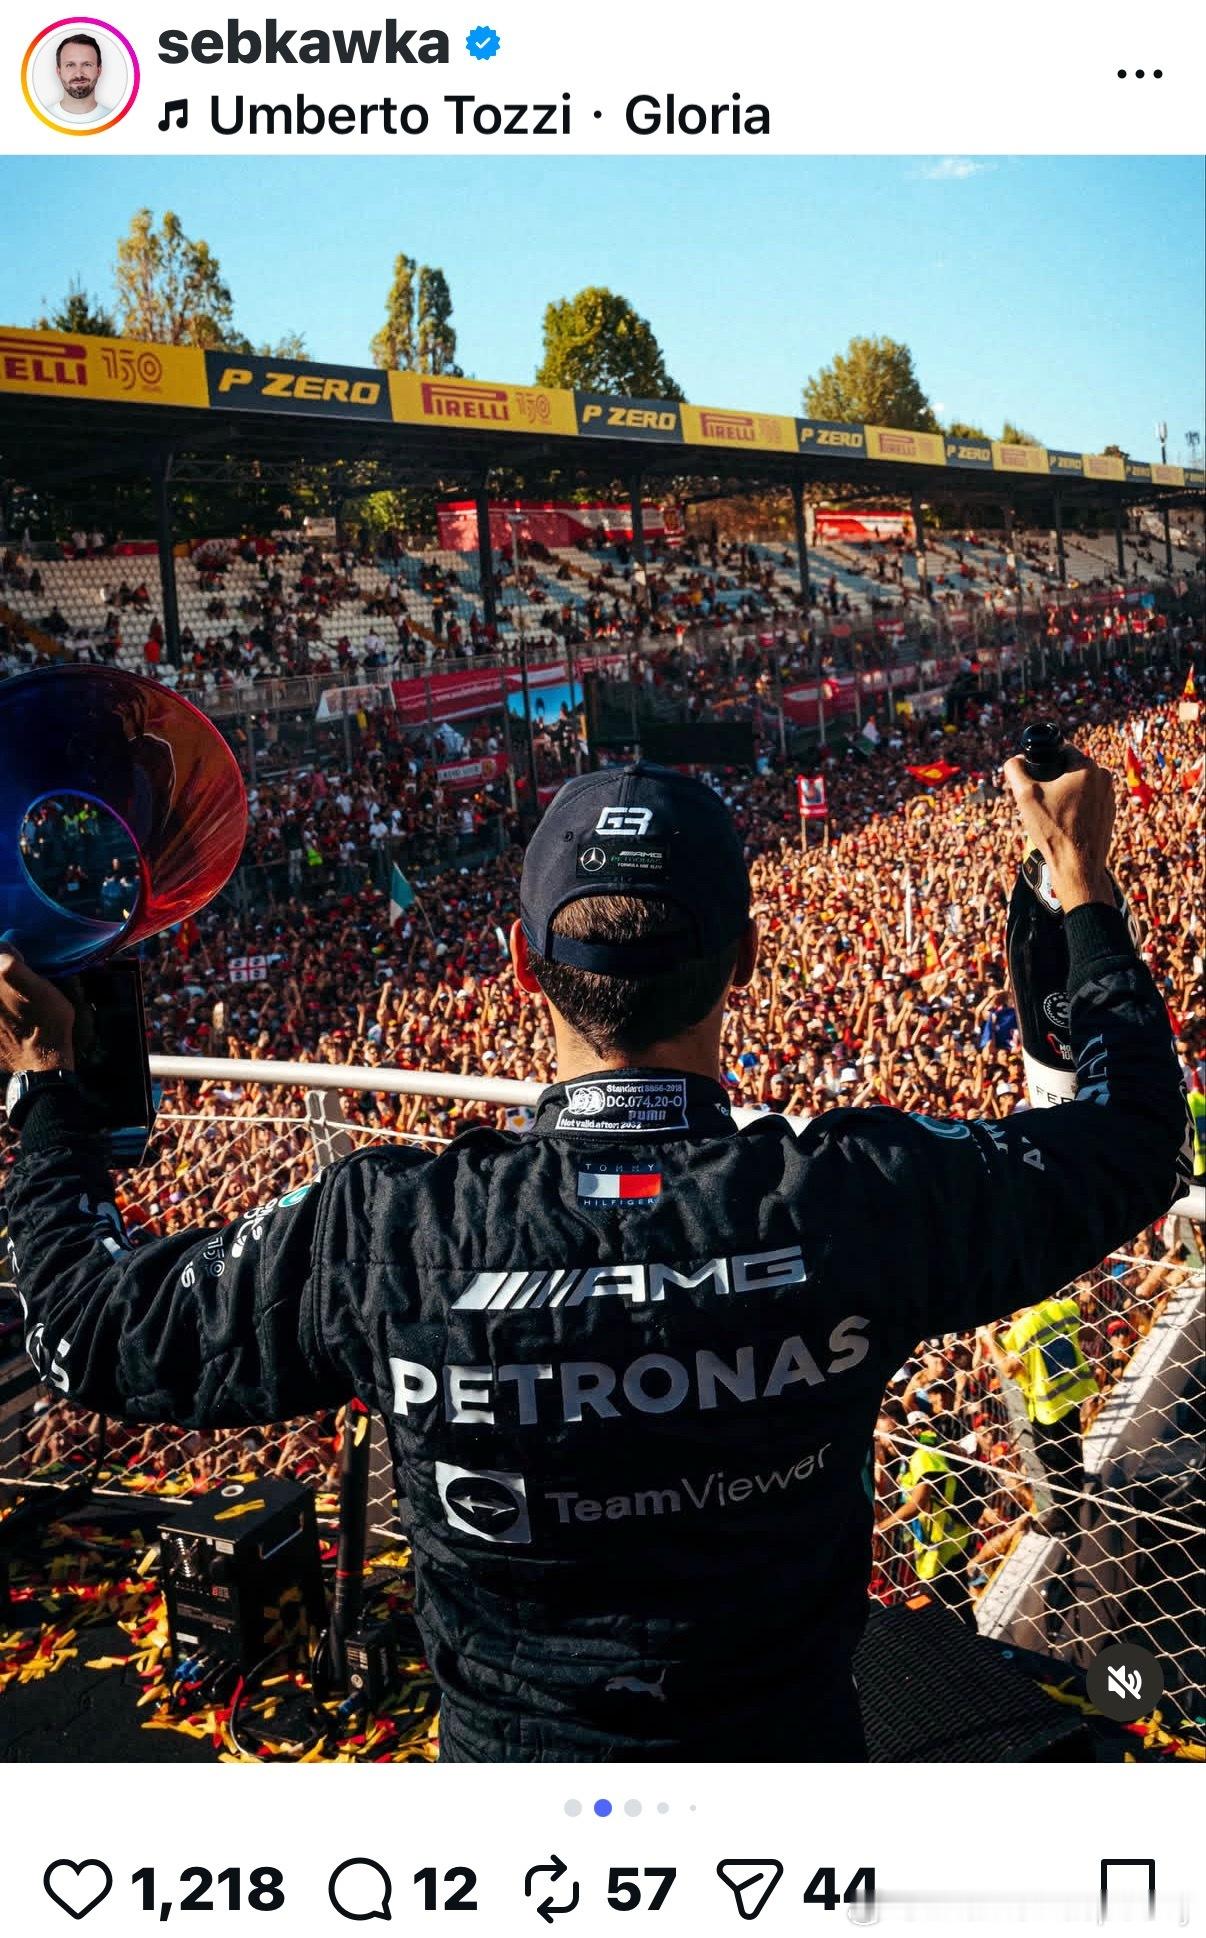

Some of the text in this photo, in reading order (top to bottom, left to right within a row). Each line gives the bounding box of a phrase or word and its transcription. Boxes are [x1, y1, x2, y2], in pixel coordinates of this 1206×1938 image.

[100, 347, 163, 391] 150
[218, 368, 381, 406] P ZERO
[421, 382, 510, 421] PIRELLI
[582, 404, 677, 431] P ZERO
[700, 412, 757, 442] PIRELLI
[800, 427, 814, 443] P
[816, 429, 863, 447] ZERO
[946, 443, 957, 458] P
[958, 446, 991, 461] ZERO
[595, 806, 654, 836] GR
[606, 1084, 644, 1093] Standard
[560, 1118, 575, 1127] Not
[585, 1163, 655, 1172] TOMMY
[563, 1245, 808, 1307] AMG
[388, 1314, 871, 1426] PETRONAS
[544, 1442, 832, 1524] TeamViewer
